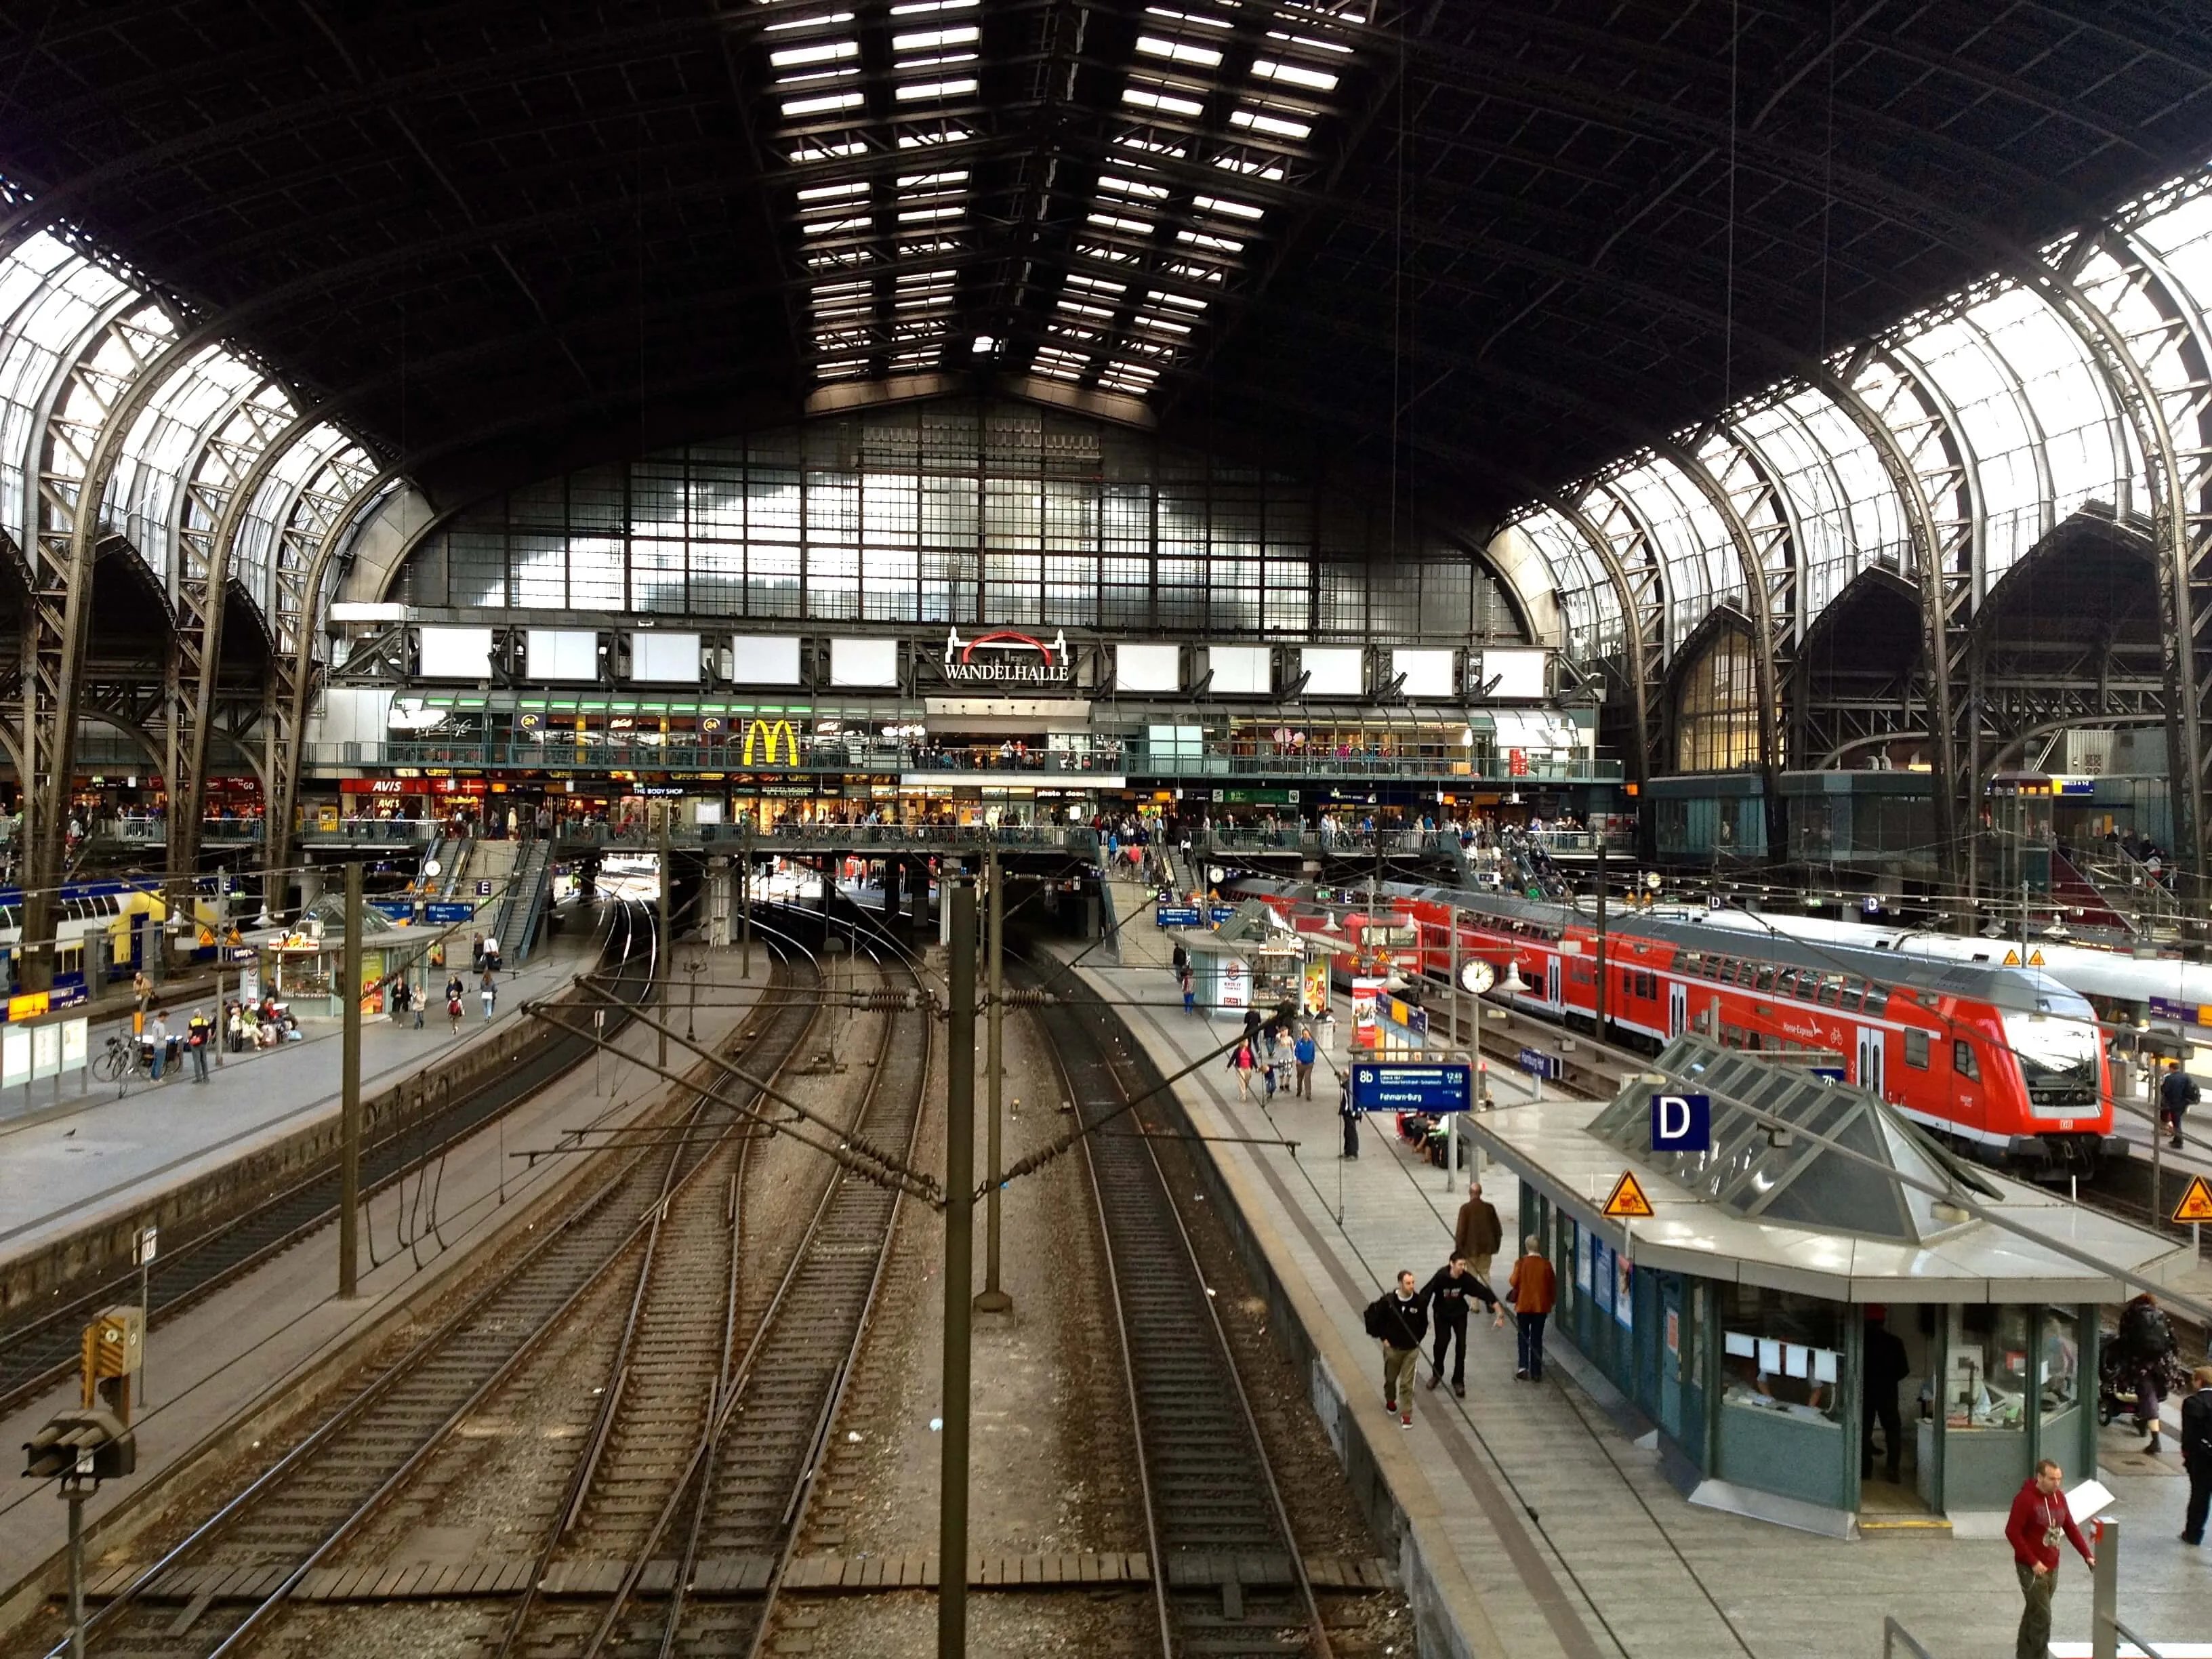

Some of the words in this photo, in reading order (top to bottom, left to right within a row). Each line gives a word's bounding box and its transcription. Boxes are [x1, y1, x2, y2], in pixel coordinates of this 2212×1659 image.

[944, 664, 1069, 681] WANDELHALLE
[243, 782, 254, 790] GO
[373, 781, 402, 792] AVIS
[377, 798, 400, 808] AVIS
[481, 882, 489, 893] E
[1359, 1070, 1374, 1083] 8b
[1380, 1093, 1422, 1103] Fehmarn-Burg
[1660, 1097, 1691, 1139] D
